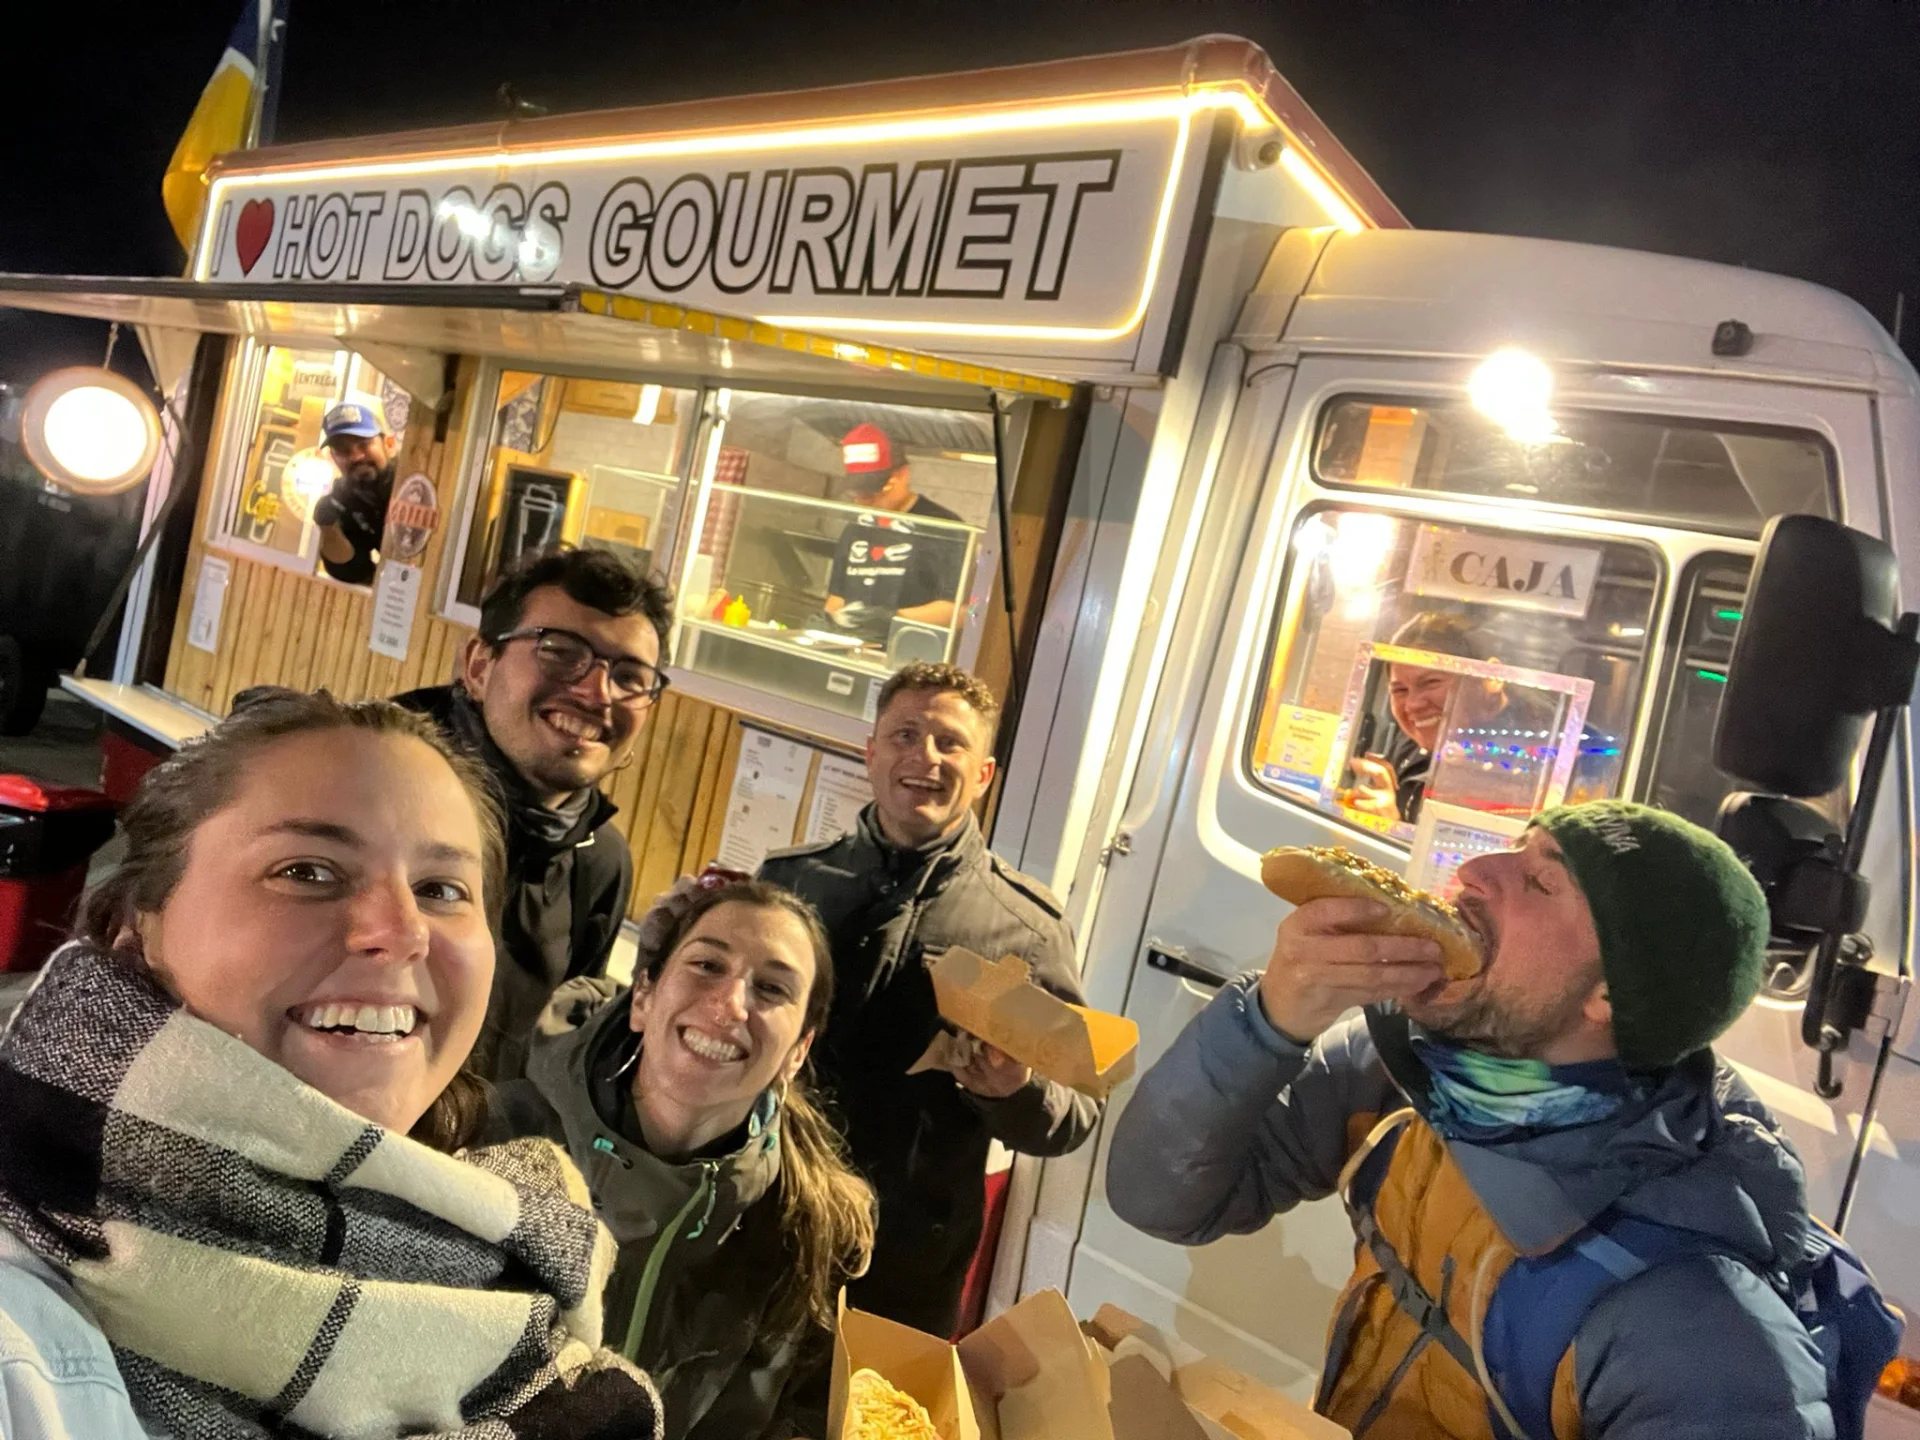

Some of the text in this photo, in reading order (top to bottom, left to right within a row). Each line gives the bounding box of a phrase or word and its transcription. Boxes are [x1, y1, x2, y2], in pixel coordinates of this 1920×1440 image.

[210, 148, 1124, 301] I HOT DOGS GOURMET
[1450, 550, 1578, 600] CAJA
